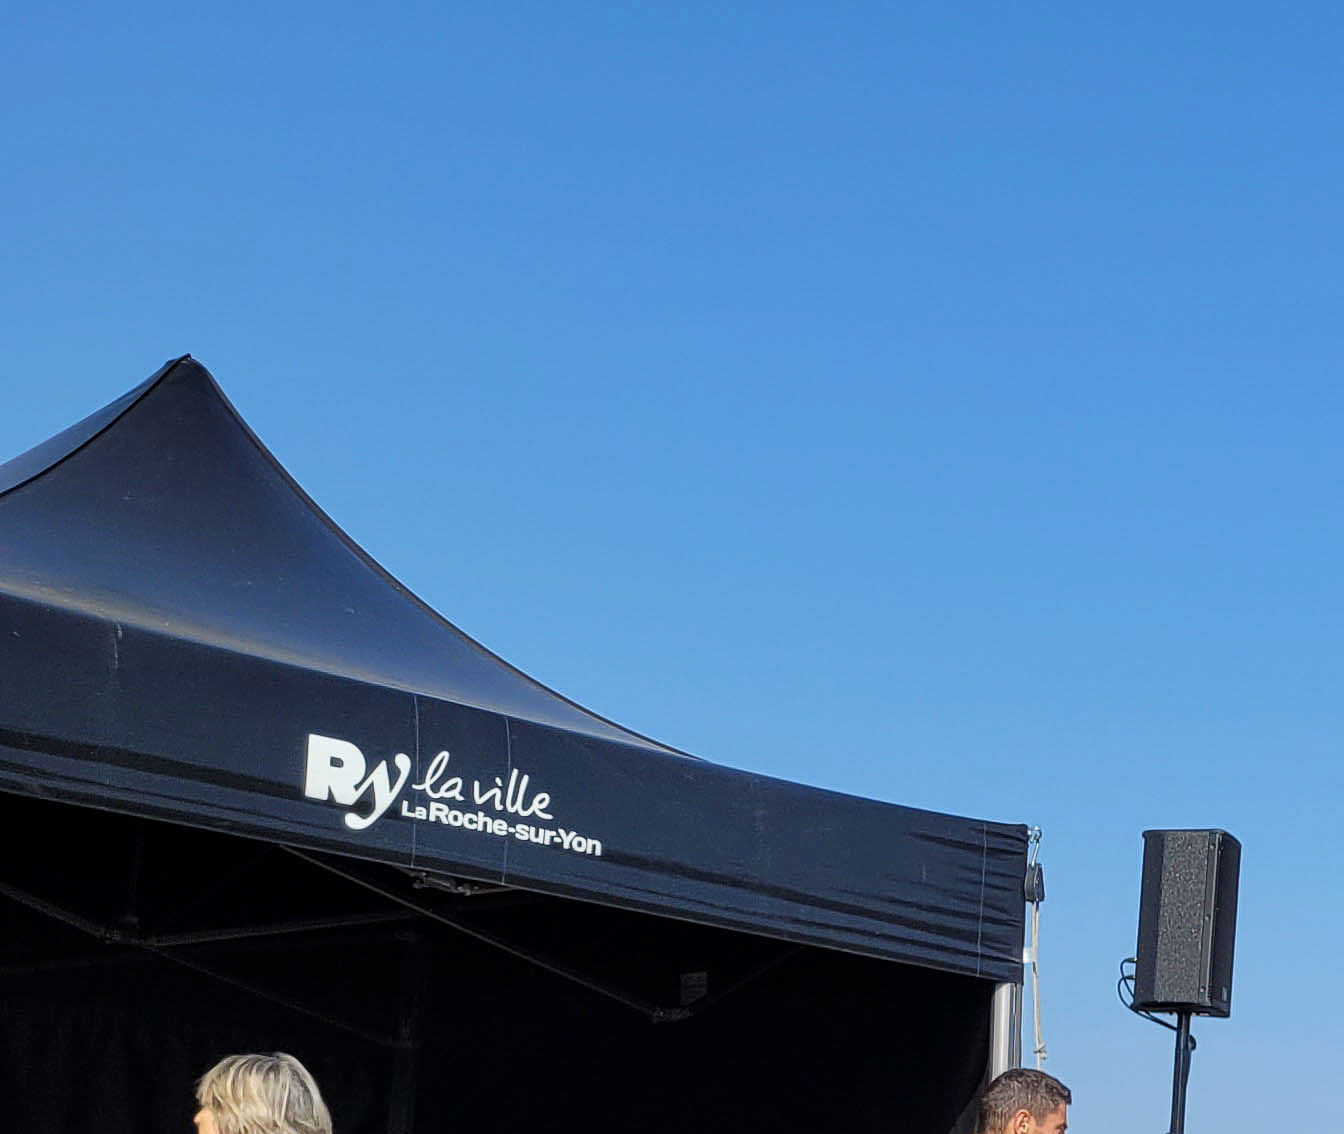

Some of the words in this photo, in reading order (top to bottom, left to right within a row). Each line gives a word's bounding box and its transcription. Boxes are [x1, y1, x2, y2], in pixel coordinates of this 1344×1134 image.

[304, 732, 412, 831] Ry
[412, 750, 465, 801] la
[472, 767, 554, 821] ville
[401, 799, 427, 821] La
[428, 801, 603, 857] Roche-sur-Yon
